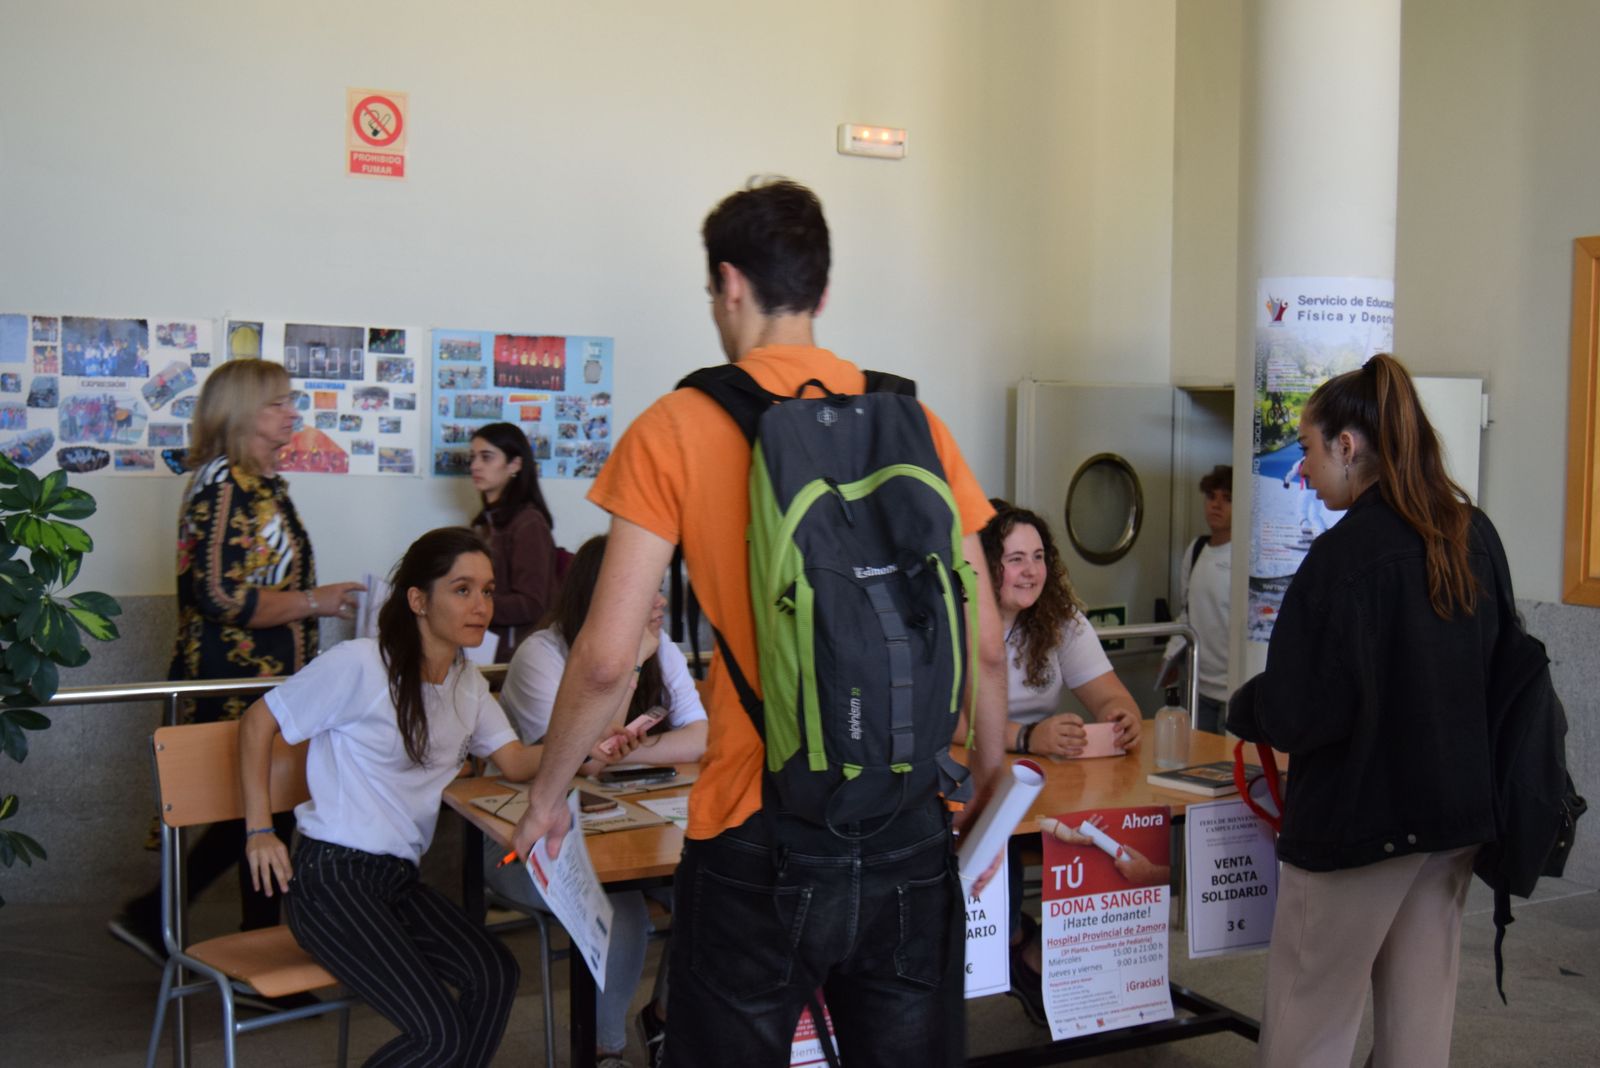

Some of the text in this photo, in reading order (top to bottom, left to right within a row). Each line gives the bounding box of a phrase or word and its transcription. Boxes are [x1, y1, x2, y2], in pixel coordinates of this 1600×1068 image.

[352, 152, 401, 164] PROHIBIDO
[361, 164, 393, 175] FUMAR
[1297, 295, 1348, 307] Servicio
[1350, 296, 1364, 307] de
[1297, 310, 1344, 321] Física
[1349, 313, 1357, 324] y
[1122, 813, 1164, 830] Ahora
[1214, 854, 1253, 870] VENTA
[1051, 856, 1084, 891] TÚ
[1211, 869, 1258, 887] BOCATA
[1201, 884, 1268, 904] SOLIDARIO
[1050, 888, 1162, 918] DONA SANGRE
[1063, 906, 1151, 931] ¡Hazte donante!
[1226, 918, 1246, 932] 3 €
[1047, 921, 1167, 948] Hospital Provincial de Zamora
[1113, 946, 1132, 958] 15:00
[1139, 942, 1158, 954] 21:00
[965, 962, 974, 975] €
[1048, 955, 1082, 968] Miércoles
[1078, 962, 1103, 974] viernes
[1117, 959, 1132, 969] 9:00
[1140, 954, 1157, 965] 15:00
[1125, 975, 1165, 994] ¡Gracias!
